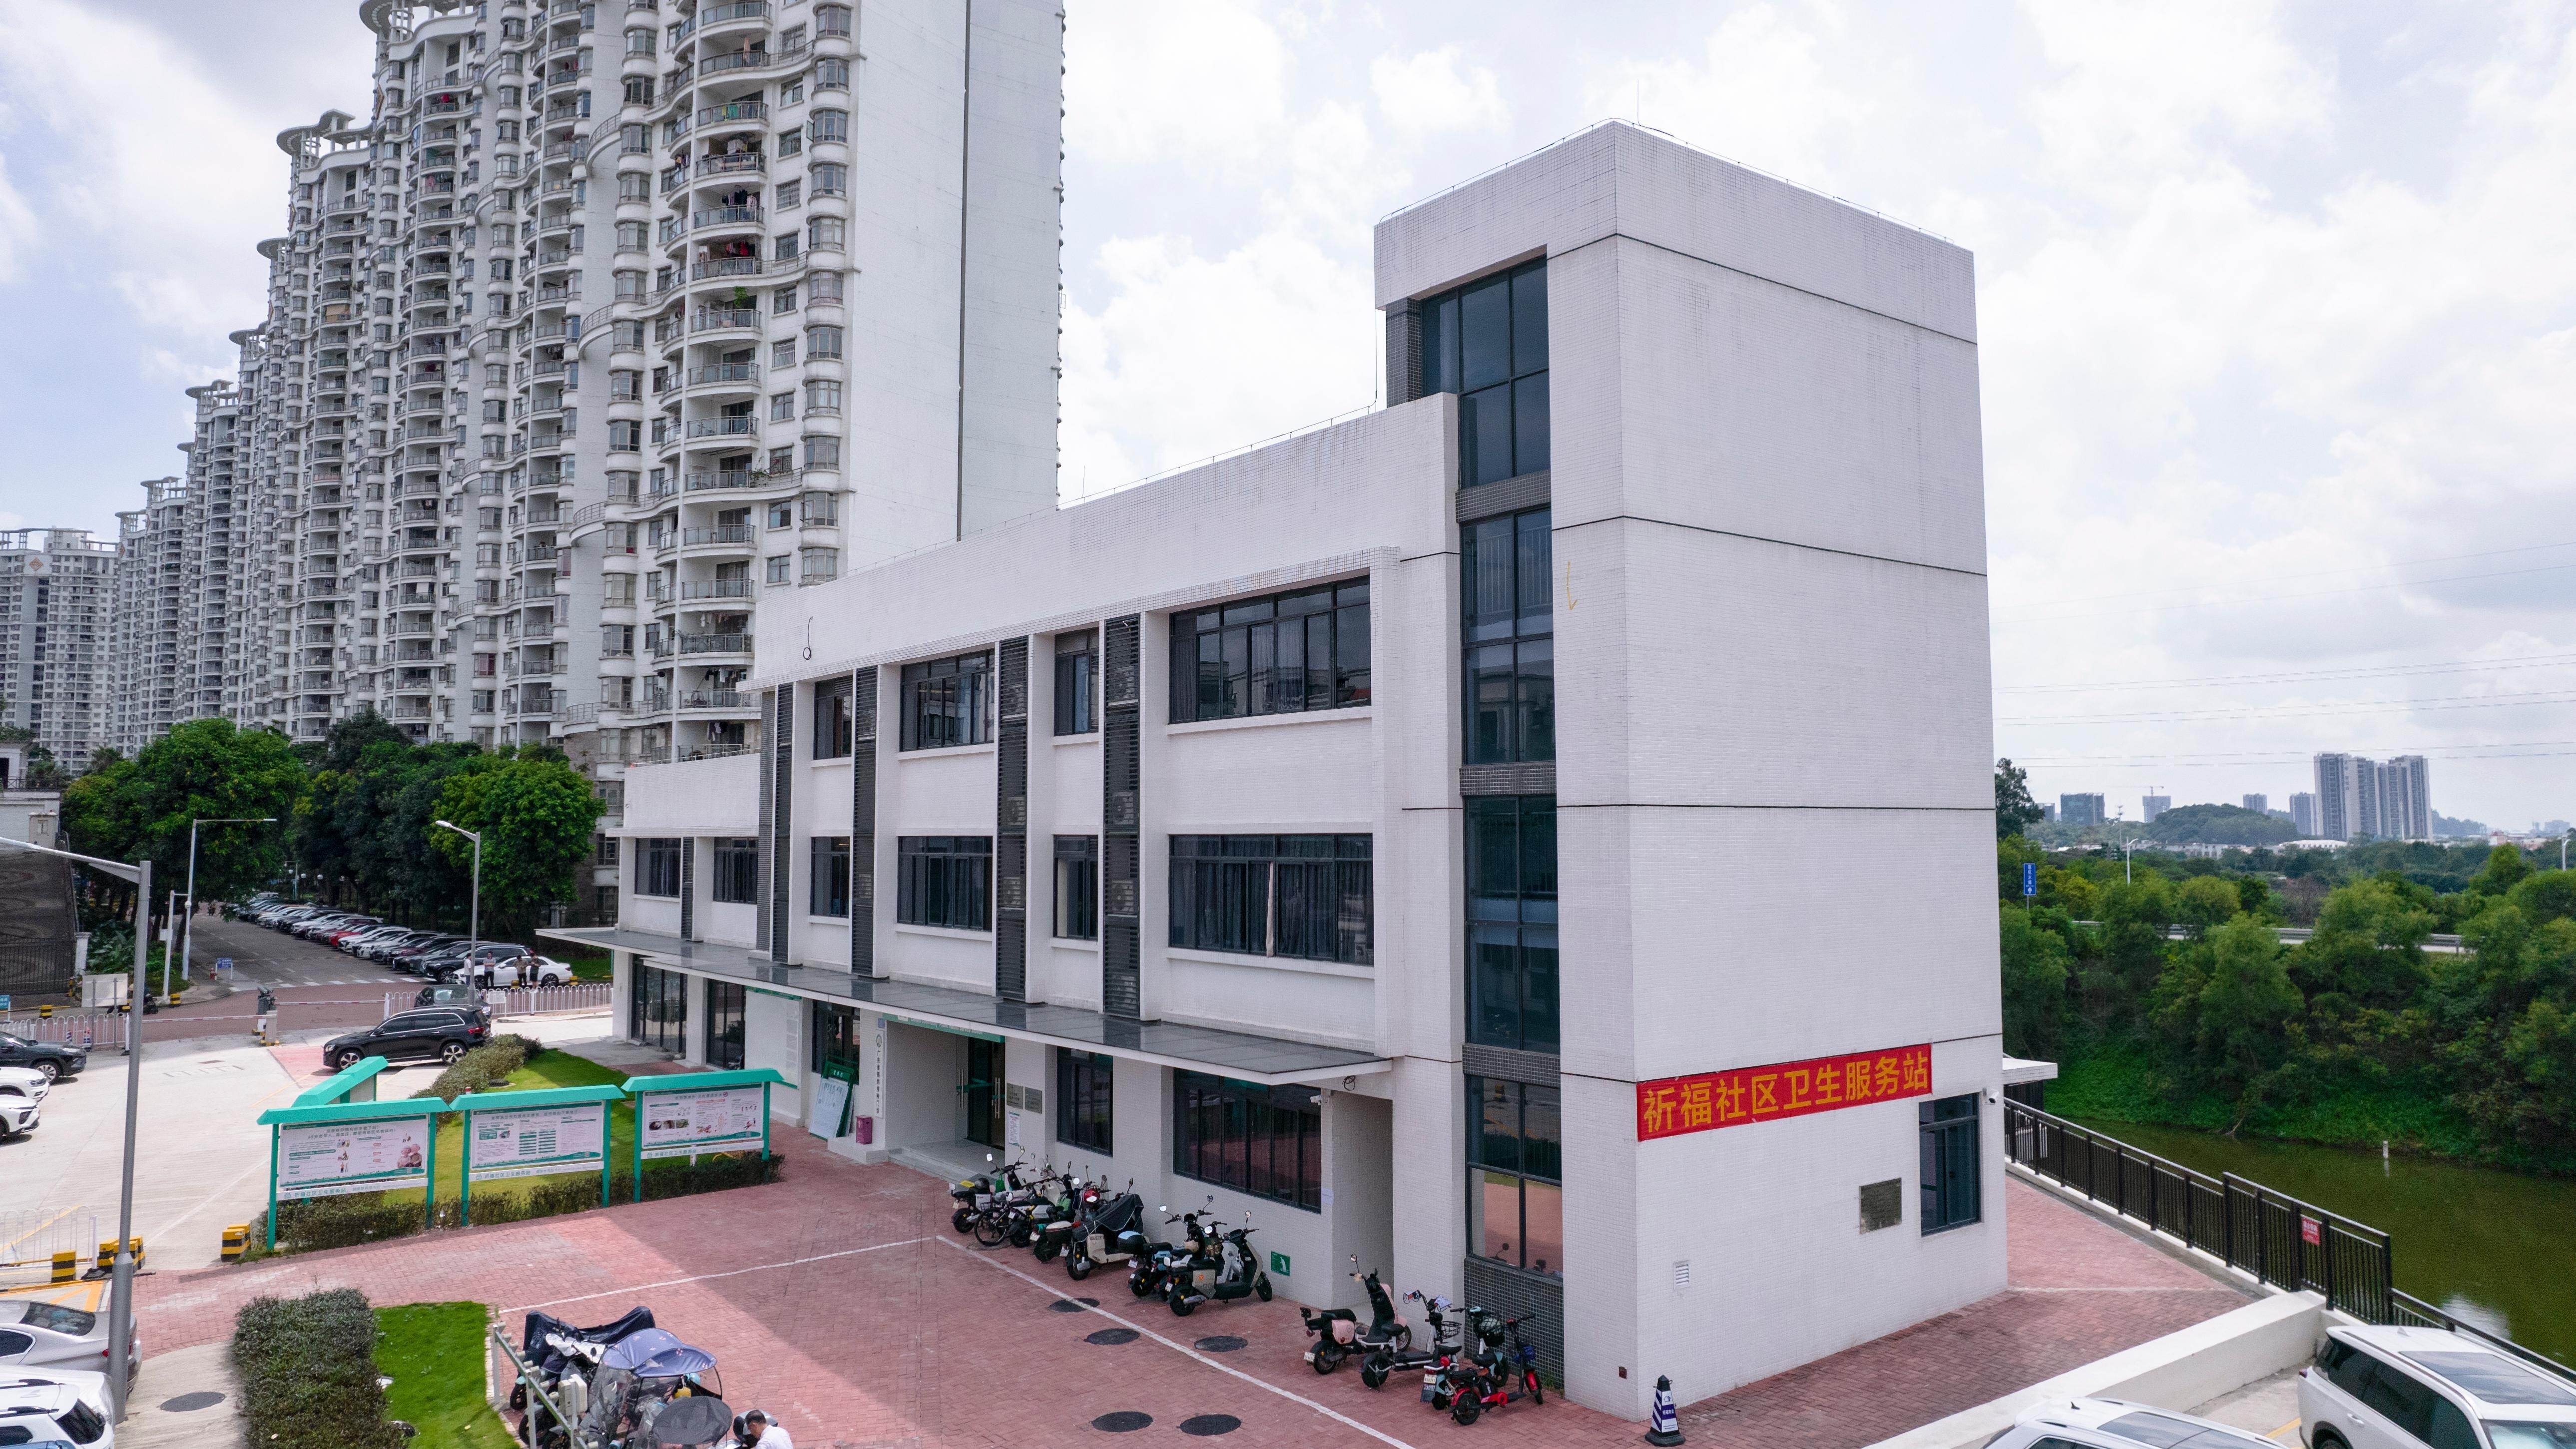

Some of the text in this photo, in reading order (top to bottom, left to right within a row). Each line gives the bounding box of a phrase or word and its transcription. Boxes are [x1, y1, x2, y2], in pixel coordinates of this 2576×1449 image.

[1644, 1051, 1928, 1132] 祈福社区卫生服务站
[484, 1170, 531, 1179] 祈福社区卫生服务站
[294, 1188, 346, 1198] 祈福社区卫生服务站
